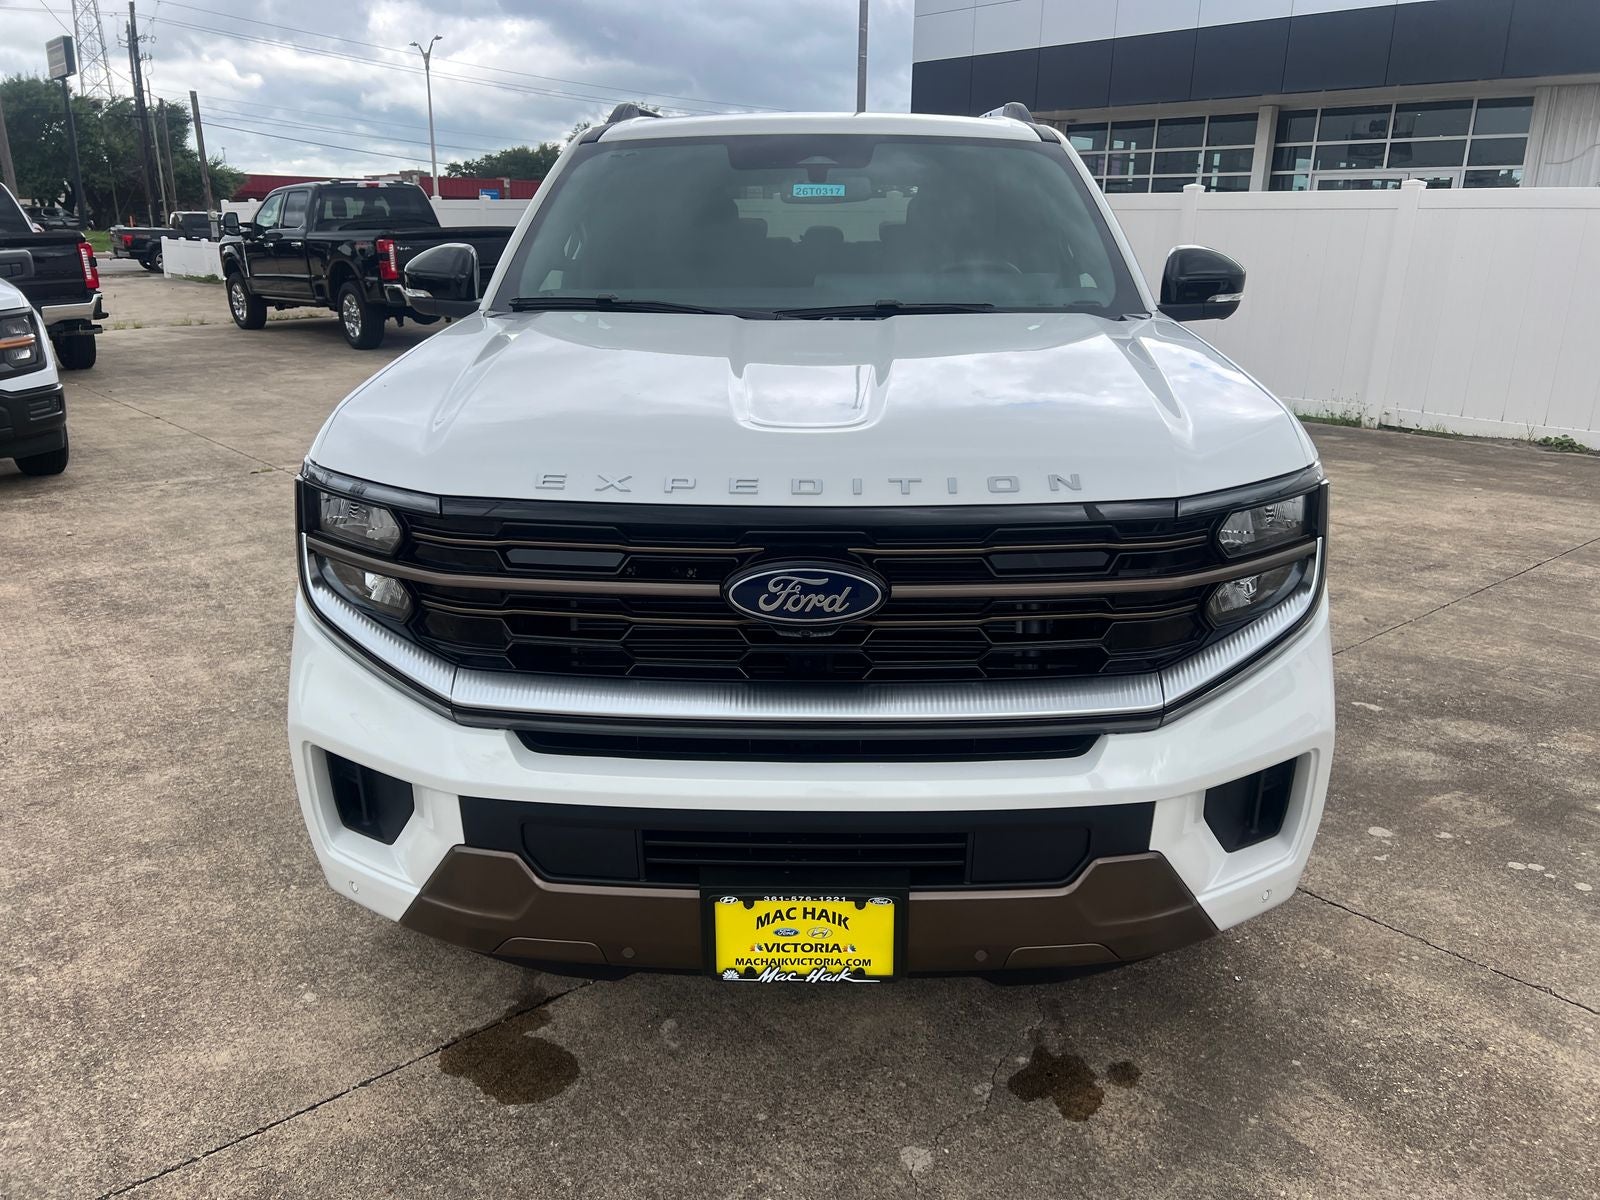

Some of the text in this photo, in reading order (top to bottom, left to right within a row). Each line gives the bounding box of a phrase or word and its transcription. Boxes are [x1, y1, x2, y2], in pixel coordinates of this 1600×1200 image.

[795, 187, 842, 196] 26T0317
[535, 471, 1083, 496] EXPEDITION
[758, 575, 852, 613] Ford
[756, 906, 850, 931] MAC HAIK
[763, 942, 843, 953] VICTORIA
[735, 957, 872, 967] MACHAIKVICTORIA.COM
[757, 966, 858, 983] Mac Haik
